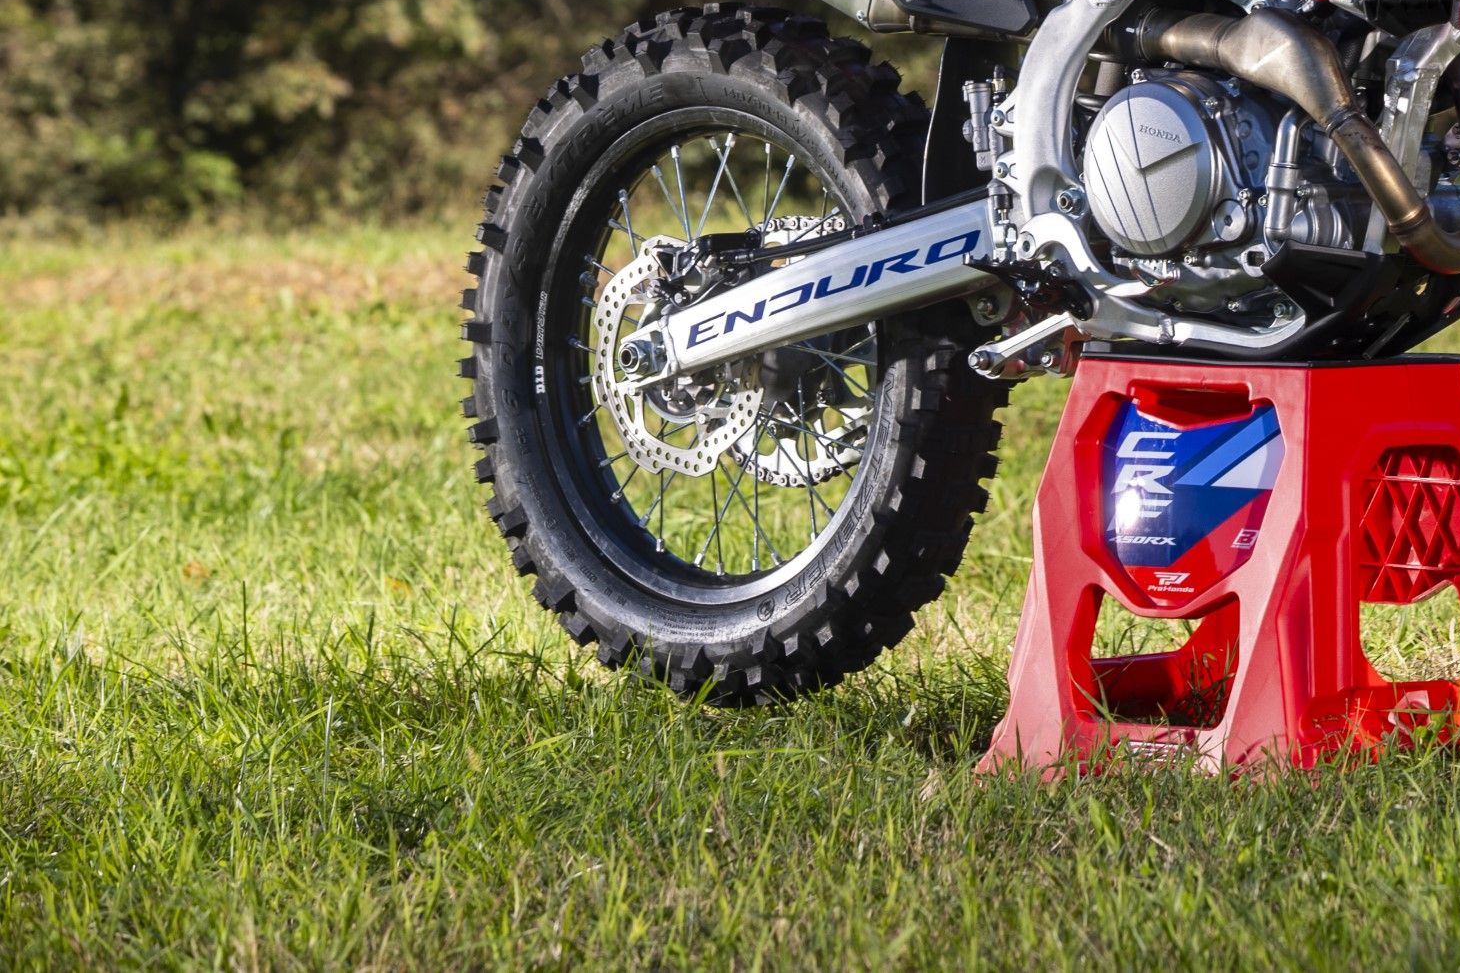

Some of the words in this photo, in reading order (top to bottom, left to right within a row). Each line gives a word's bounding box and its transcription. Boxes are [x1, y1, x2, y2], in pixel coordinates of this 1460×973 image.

[1139, 124, 1183, 144] HONDA
[686, 229, 981, 350] ENDURO
[1147, 584, 1195, 593] ProHonda
